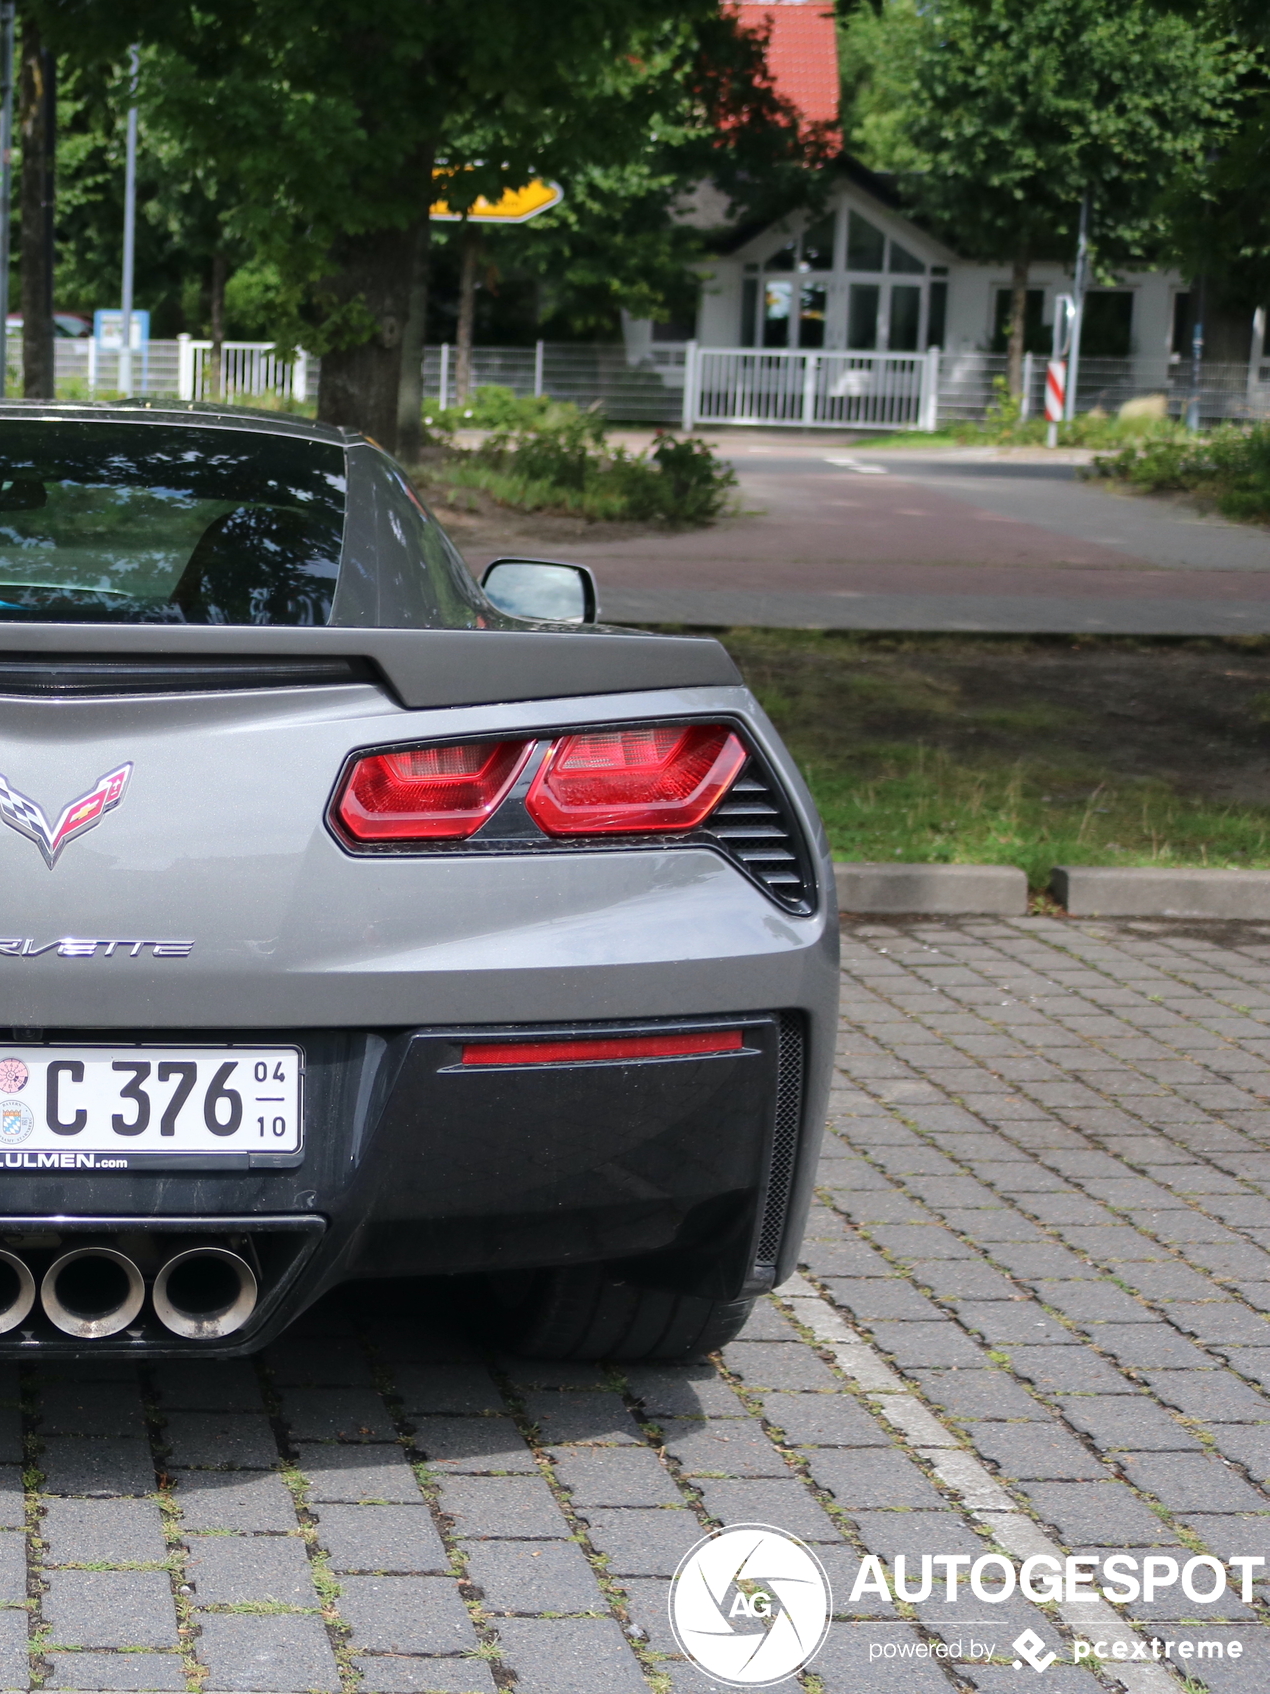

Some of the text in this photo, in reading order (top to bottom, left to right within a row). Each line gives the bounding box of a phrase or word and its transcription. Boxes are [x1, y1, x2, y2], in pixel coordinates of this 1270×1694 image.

[254, 1061, 286, 1083] 04
[45, 1060, 88, 1137] C
[111, 1060, 243, 1137] 376
[257, 1116, 286, 1137] 10
